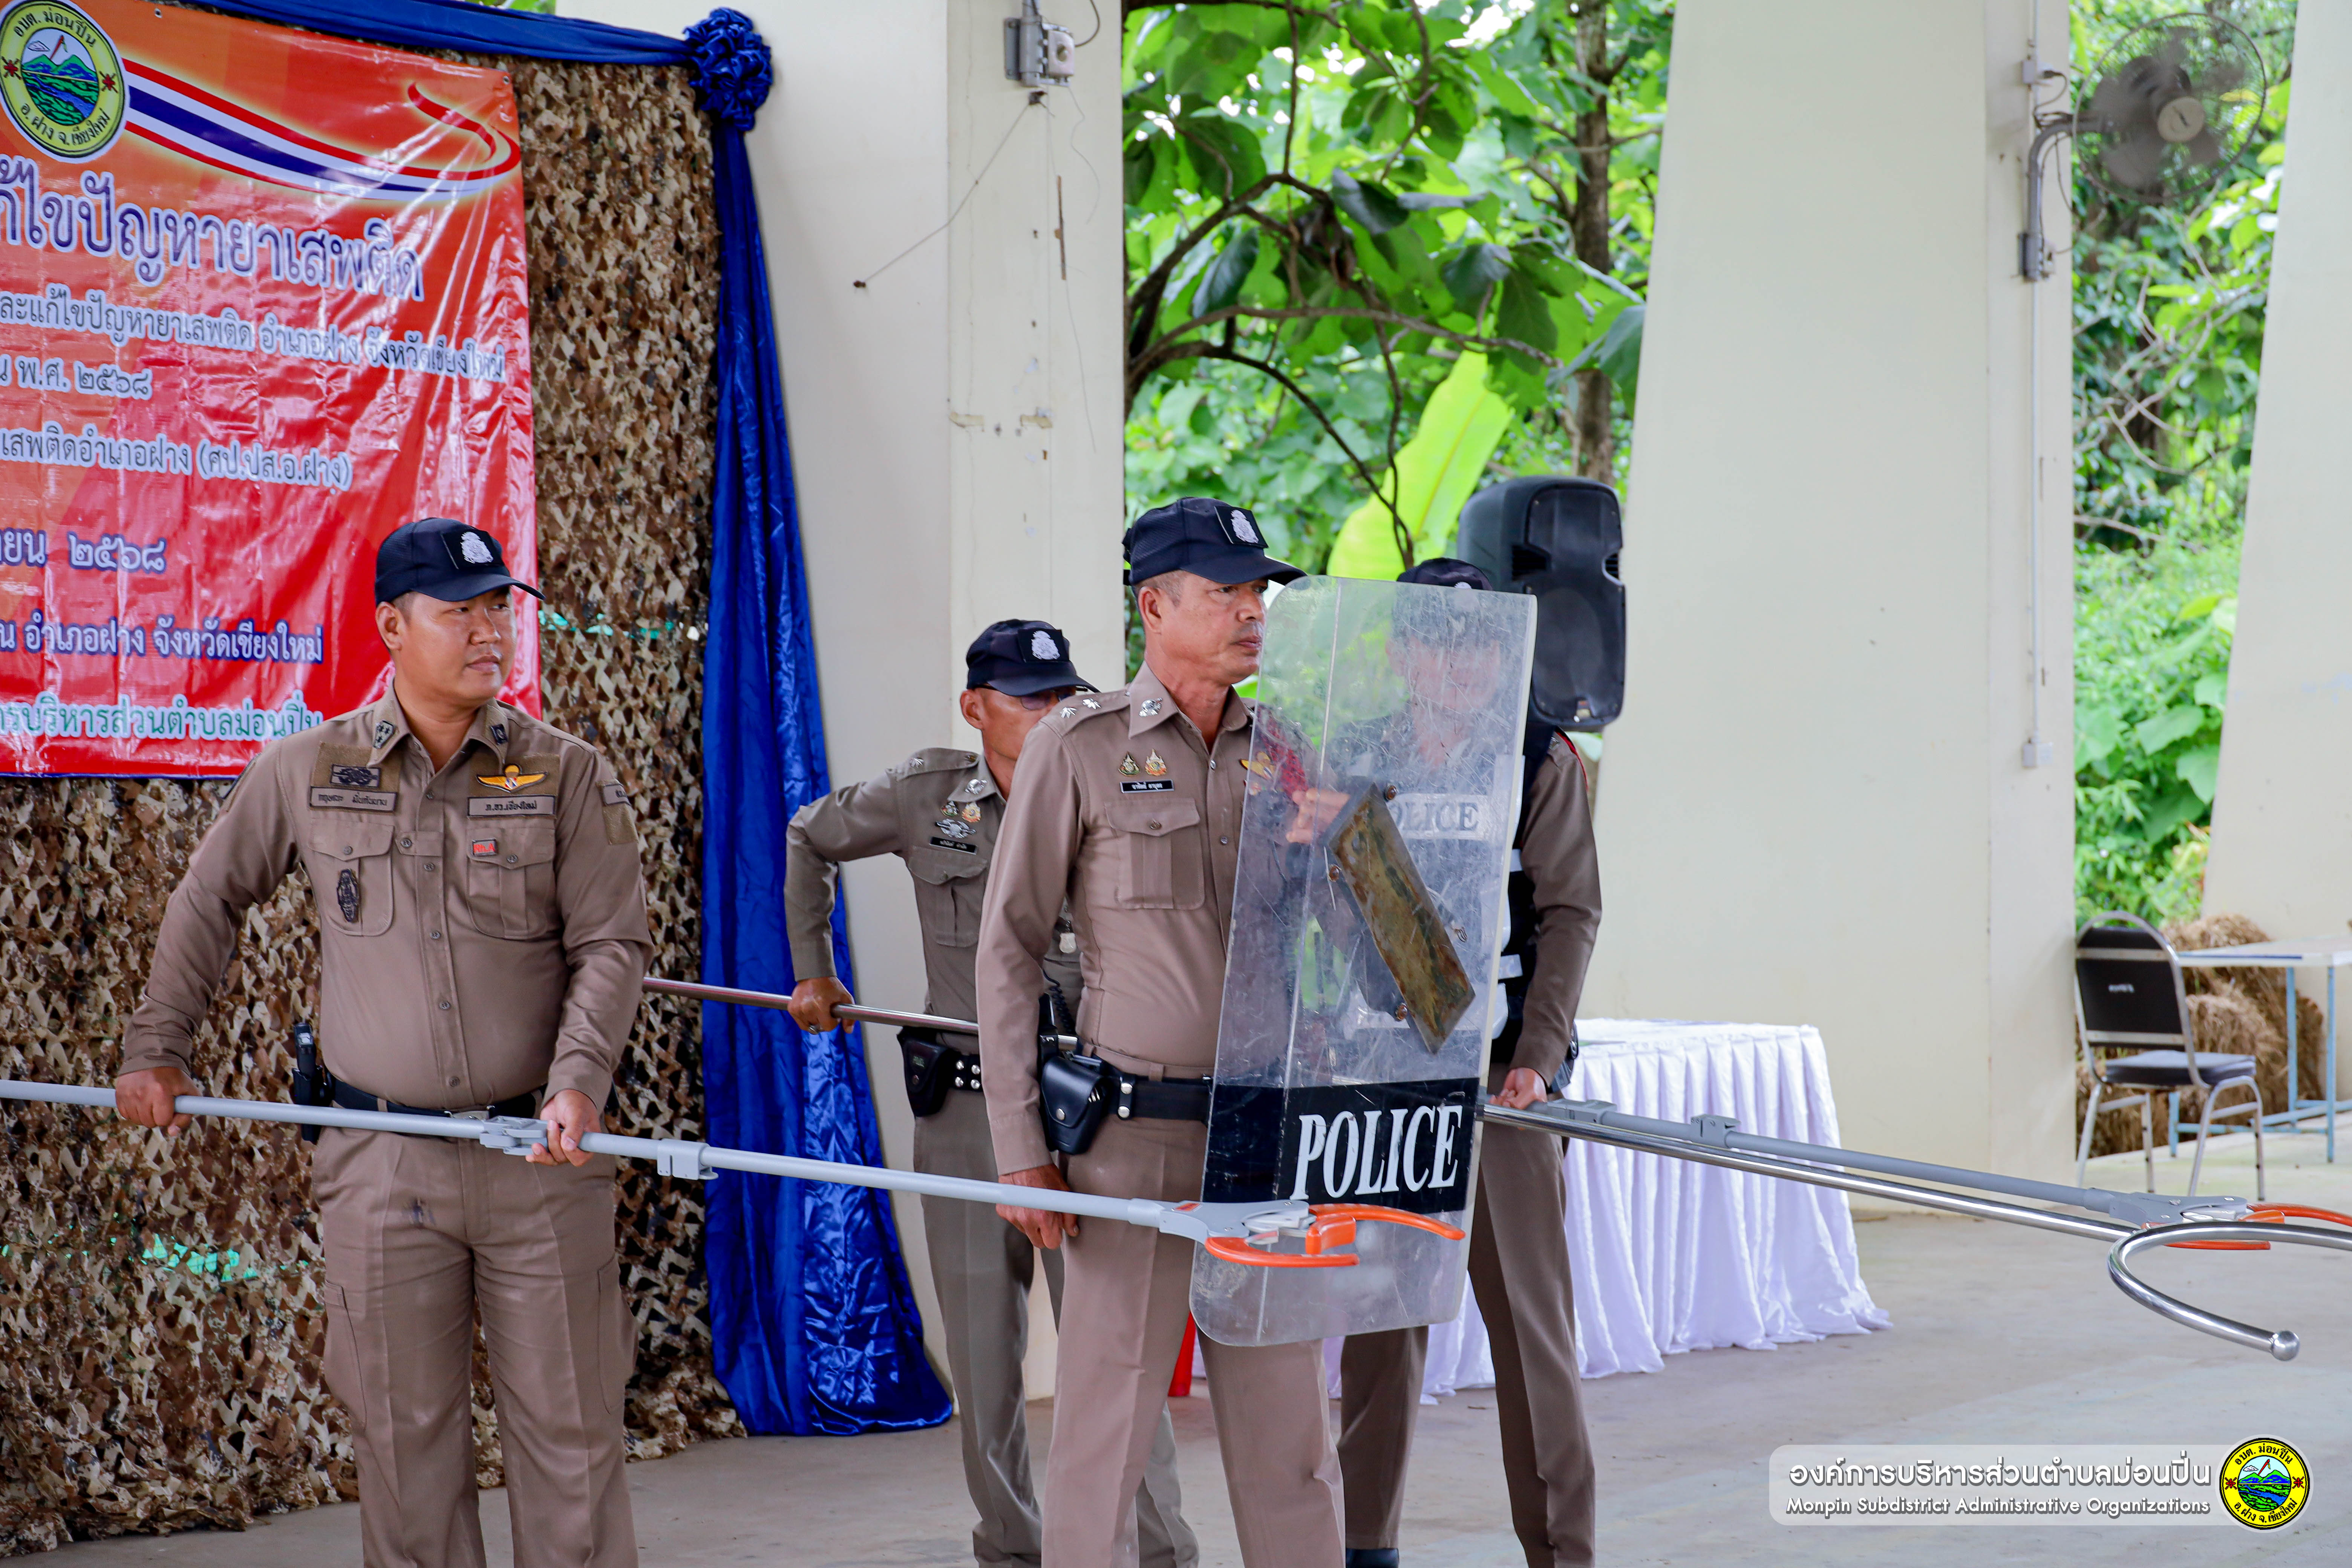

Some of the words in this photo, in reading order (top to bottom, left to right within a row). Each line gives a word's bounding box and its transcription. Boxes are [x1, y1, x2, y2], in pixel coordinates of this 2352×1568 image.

[19, 360, 67, 387] พ.ศ.
[78, 366, 149, 395] ๒๕๖๘
[3, 425, 188, 473] เสพติดอำเภอฝาง
[0, 530, 46, 564] ยน
[69, 534, 165, 571] ๒๕๖๘
[25, 611, 144, 655] อำเภอฝาง
[154, 616, 323, 662] จังหวัดเชียงใหม่
[1290, 1105, 1462, 1200] POLICE
